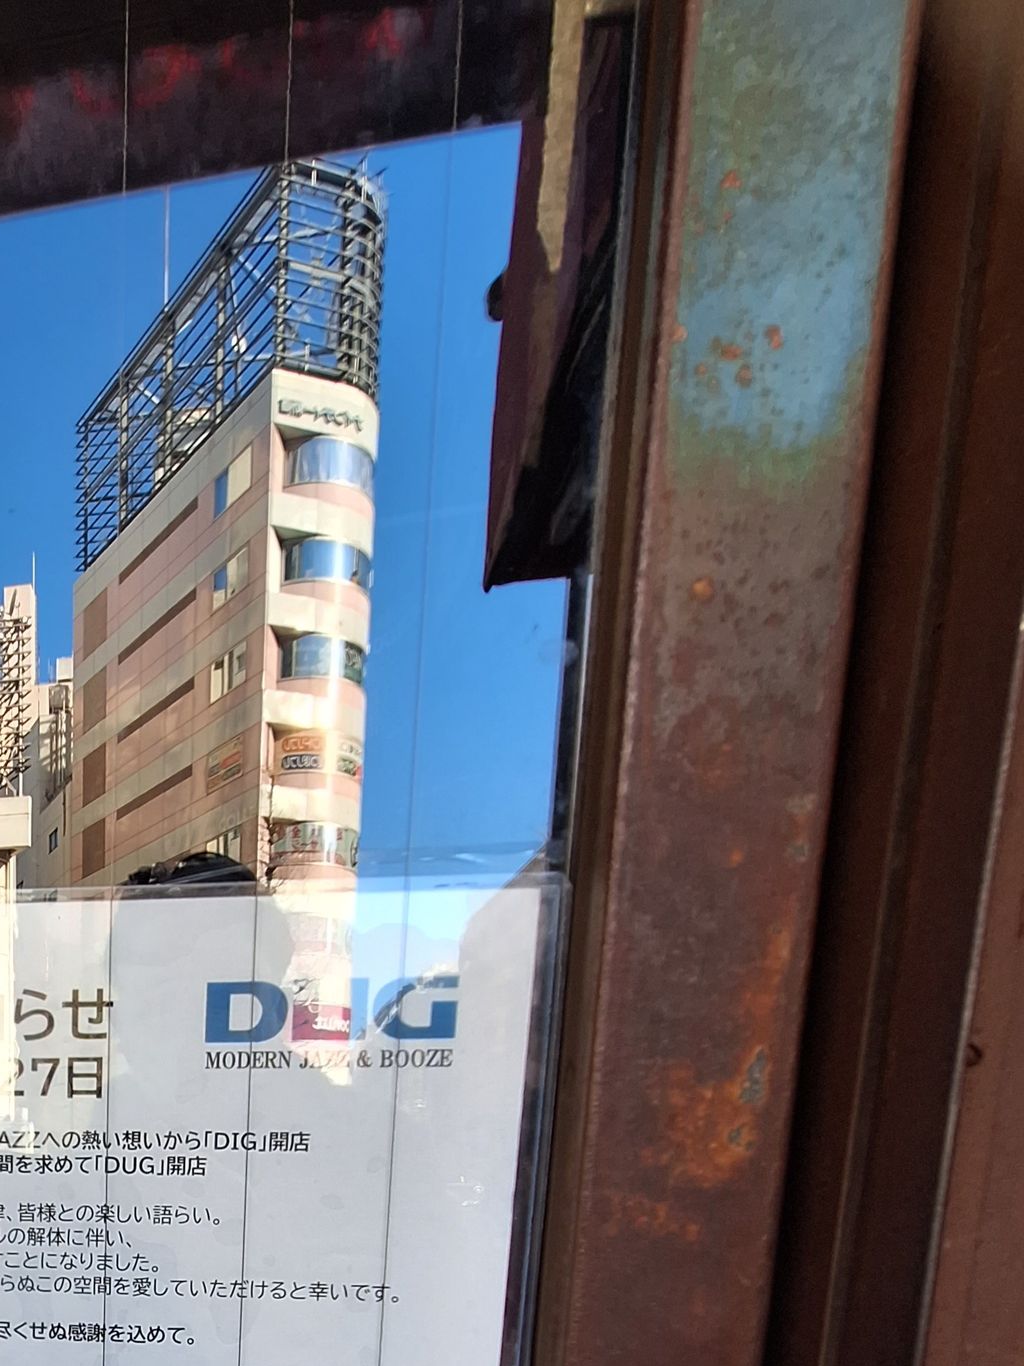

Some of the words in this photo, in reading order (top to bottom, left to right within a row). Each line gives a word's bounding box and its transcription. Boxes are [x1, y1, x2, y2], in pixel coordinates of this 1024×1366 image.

[205, 1051, 292, 1070] MODERN
[357, 1051, 371, 1068] &
[380, 1049, 453, 1068] BOOZE
